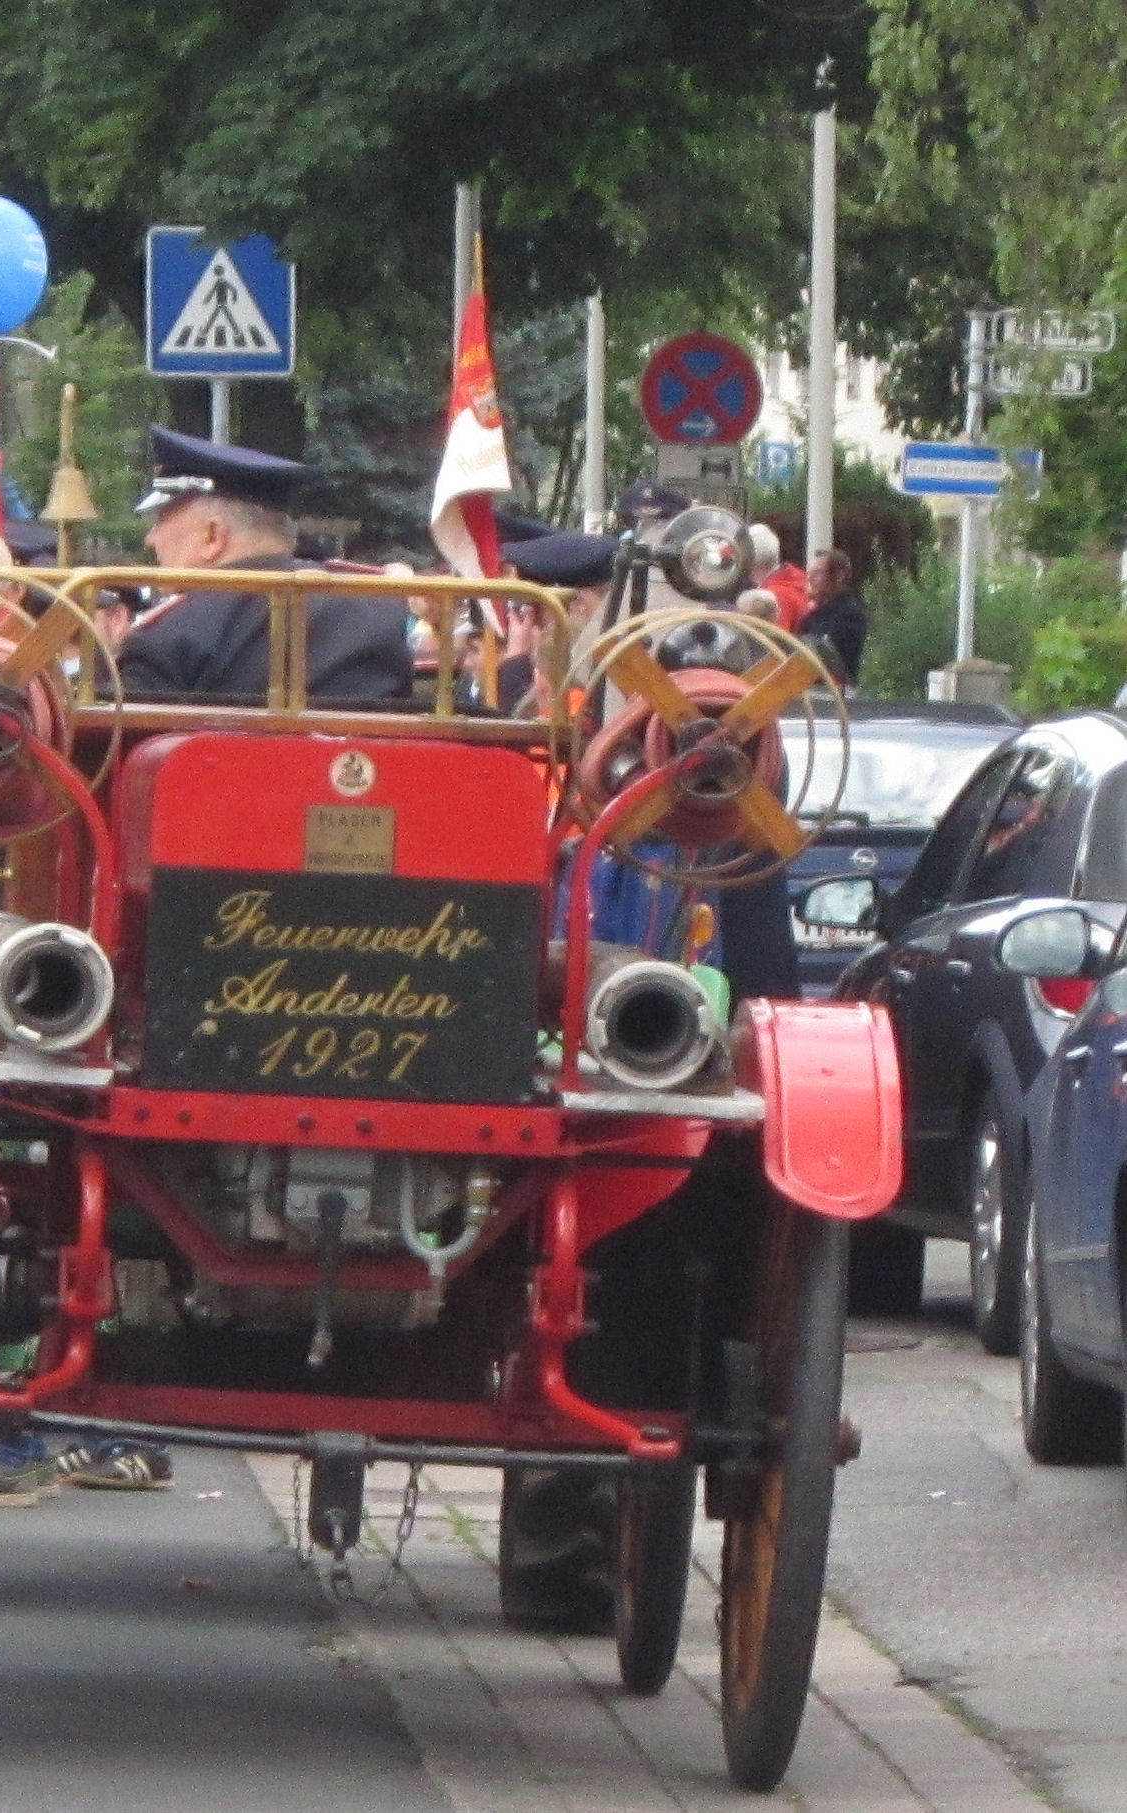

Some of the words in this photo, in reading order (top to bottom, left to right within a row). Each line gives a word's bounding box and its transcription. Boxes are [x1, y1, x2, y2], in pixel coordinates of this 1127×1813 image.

[204, 890, 491, 962] Feuerwehr
[204, 958, 464, 1018] Anderten
[258, 1027, 428, 1081] 1927
